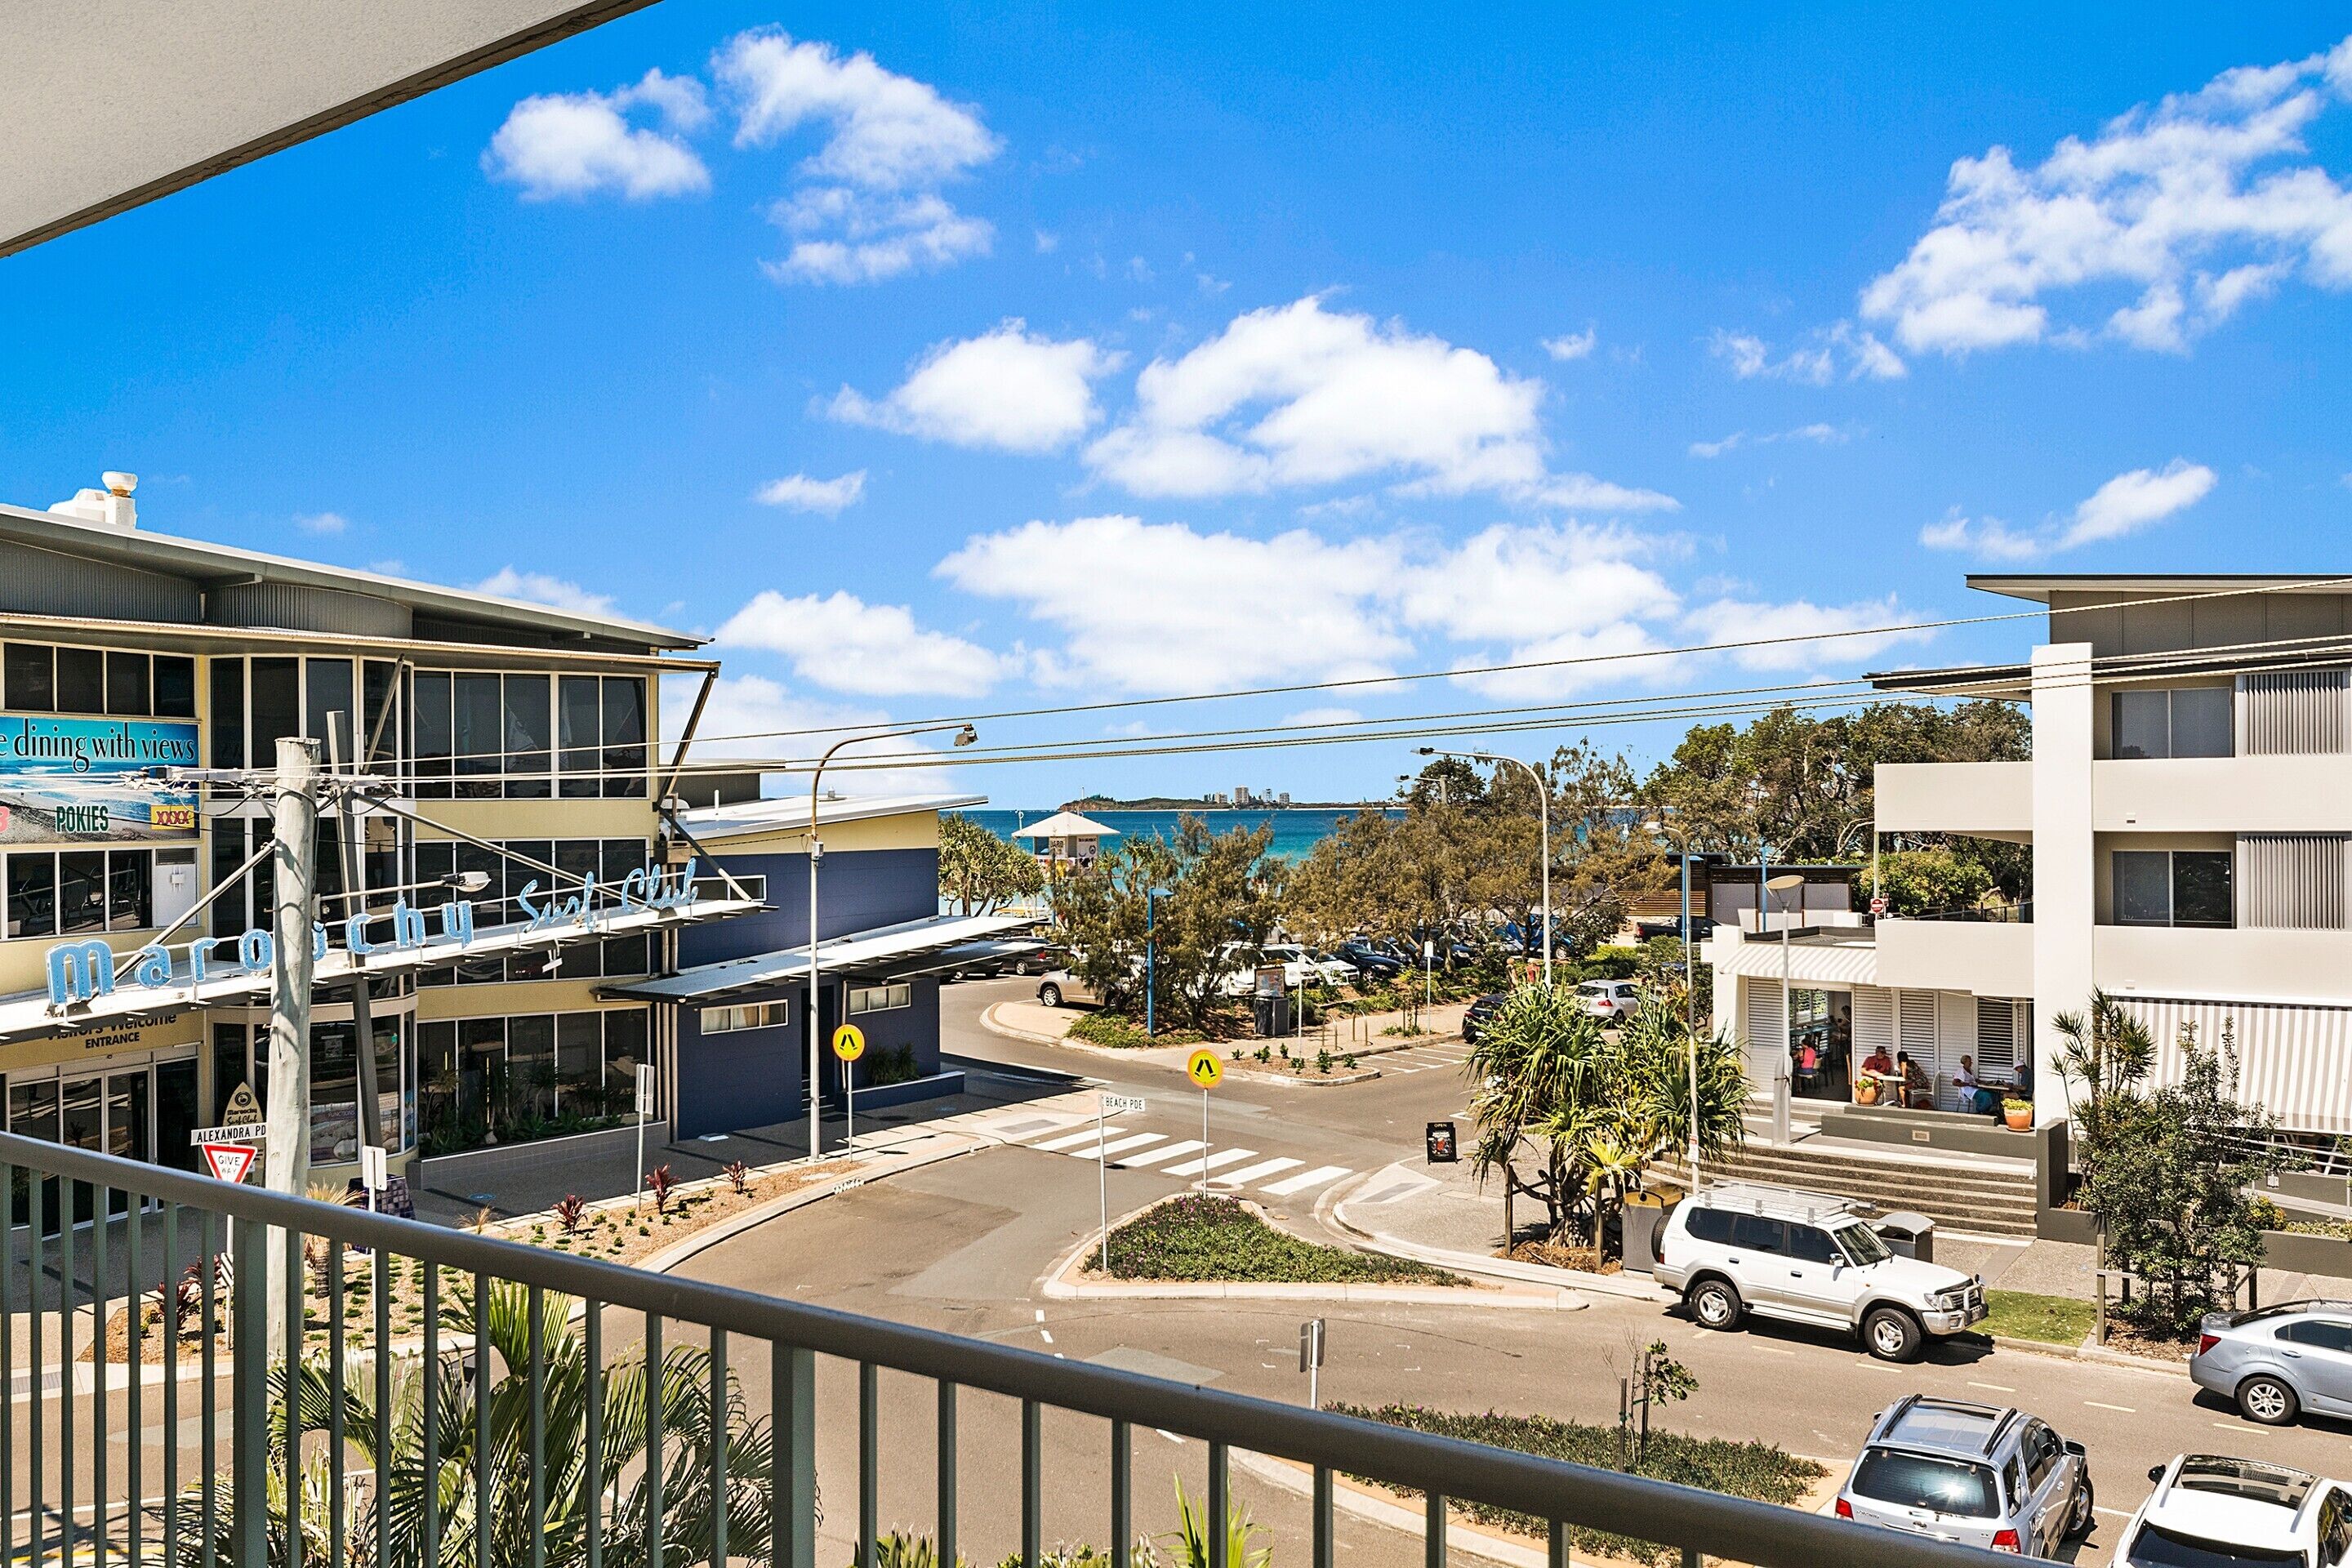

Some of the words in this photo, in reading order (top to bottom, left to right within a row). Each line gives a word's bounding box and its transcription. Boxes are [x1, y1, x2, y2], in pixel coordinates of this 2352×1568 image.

[14, 718, 91, 773] dining
[91, 722, 136, 759] with
[141, 729, 194, 760] views
[56, 805, 109, 832] POKIES
[156, 810, 189, 825] XXXX
[517, 871, 598, 933] Surf
[621, 858, 699, 915] Club
[86, 1031, 140, 1049] ENTRANCE
[1106, 1097, 1127, 1107] BEACH
[1129, 1099, 1143, 1109] PDE
[197, 1127, 251, 1143] ALEXANDRA
[218, 1155, 241, 1166] GIVE
